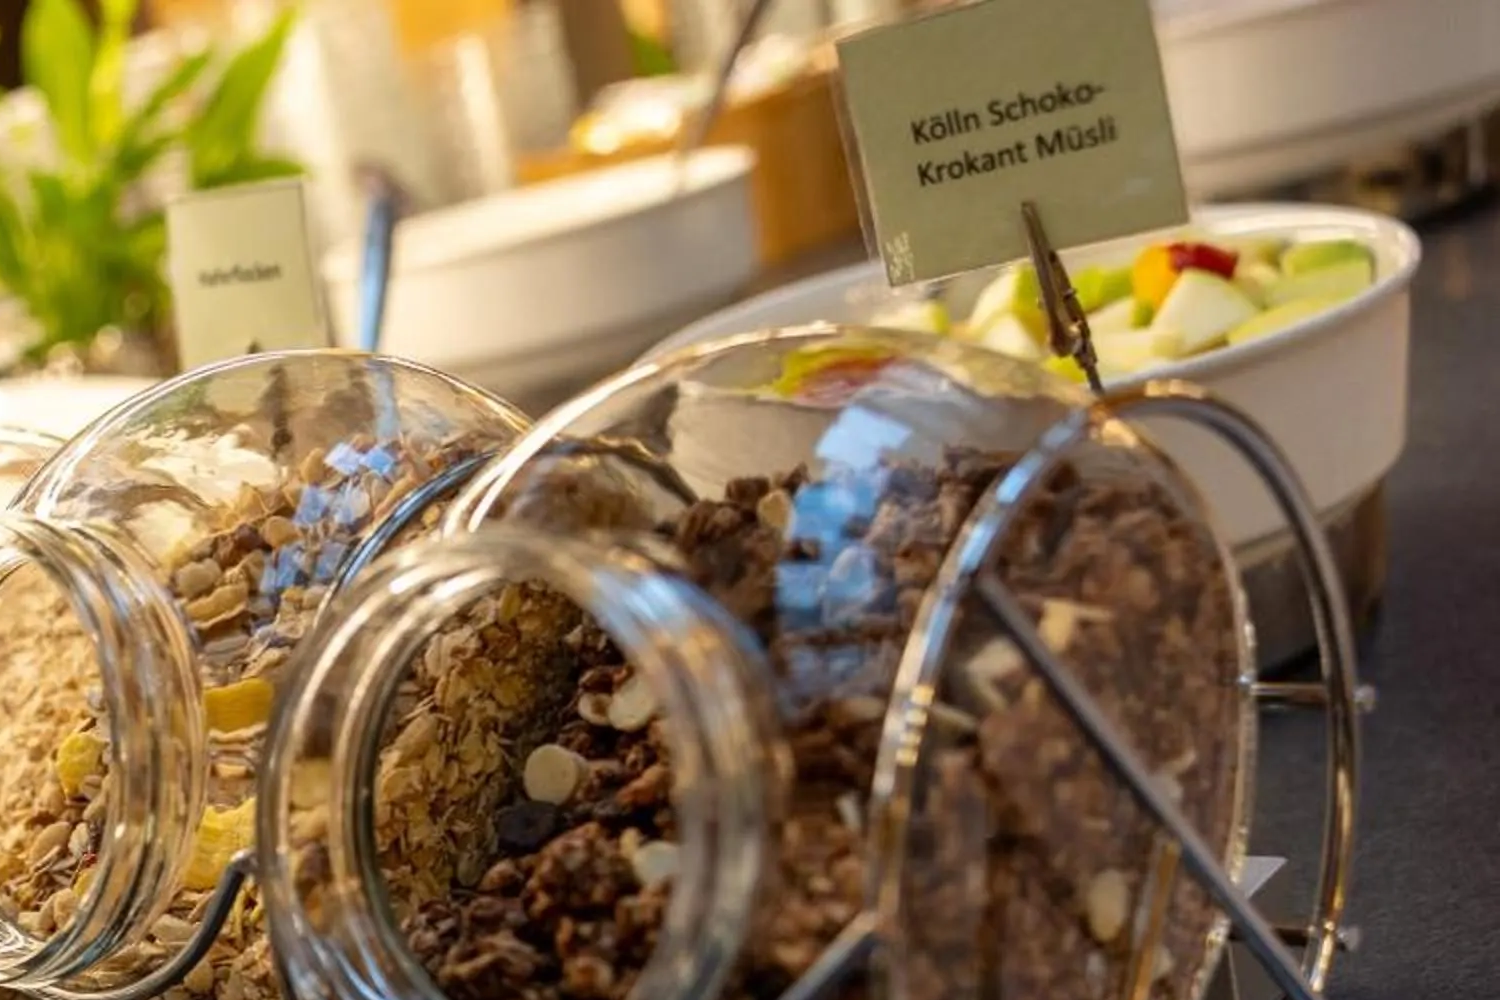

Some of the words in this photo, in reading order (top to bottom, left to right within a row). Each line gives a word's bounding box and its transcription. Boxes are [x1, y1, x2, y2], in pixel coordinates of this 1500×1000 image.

[911, 108, 980, 145] Kölln
[988, 82, 1107, 127] Schoko-
[917, 141, 1029, 187] Krokant
[1035, 116, 1118, 160] Müsli
